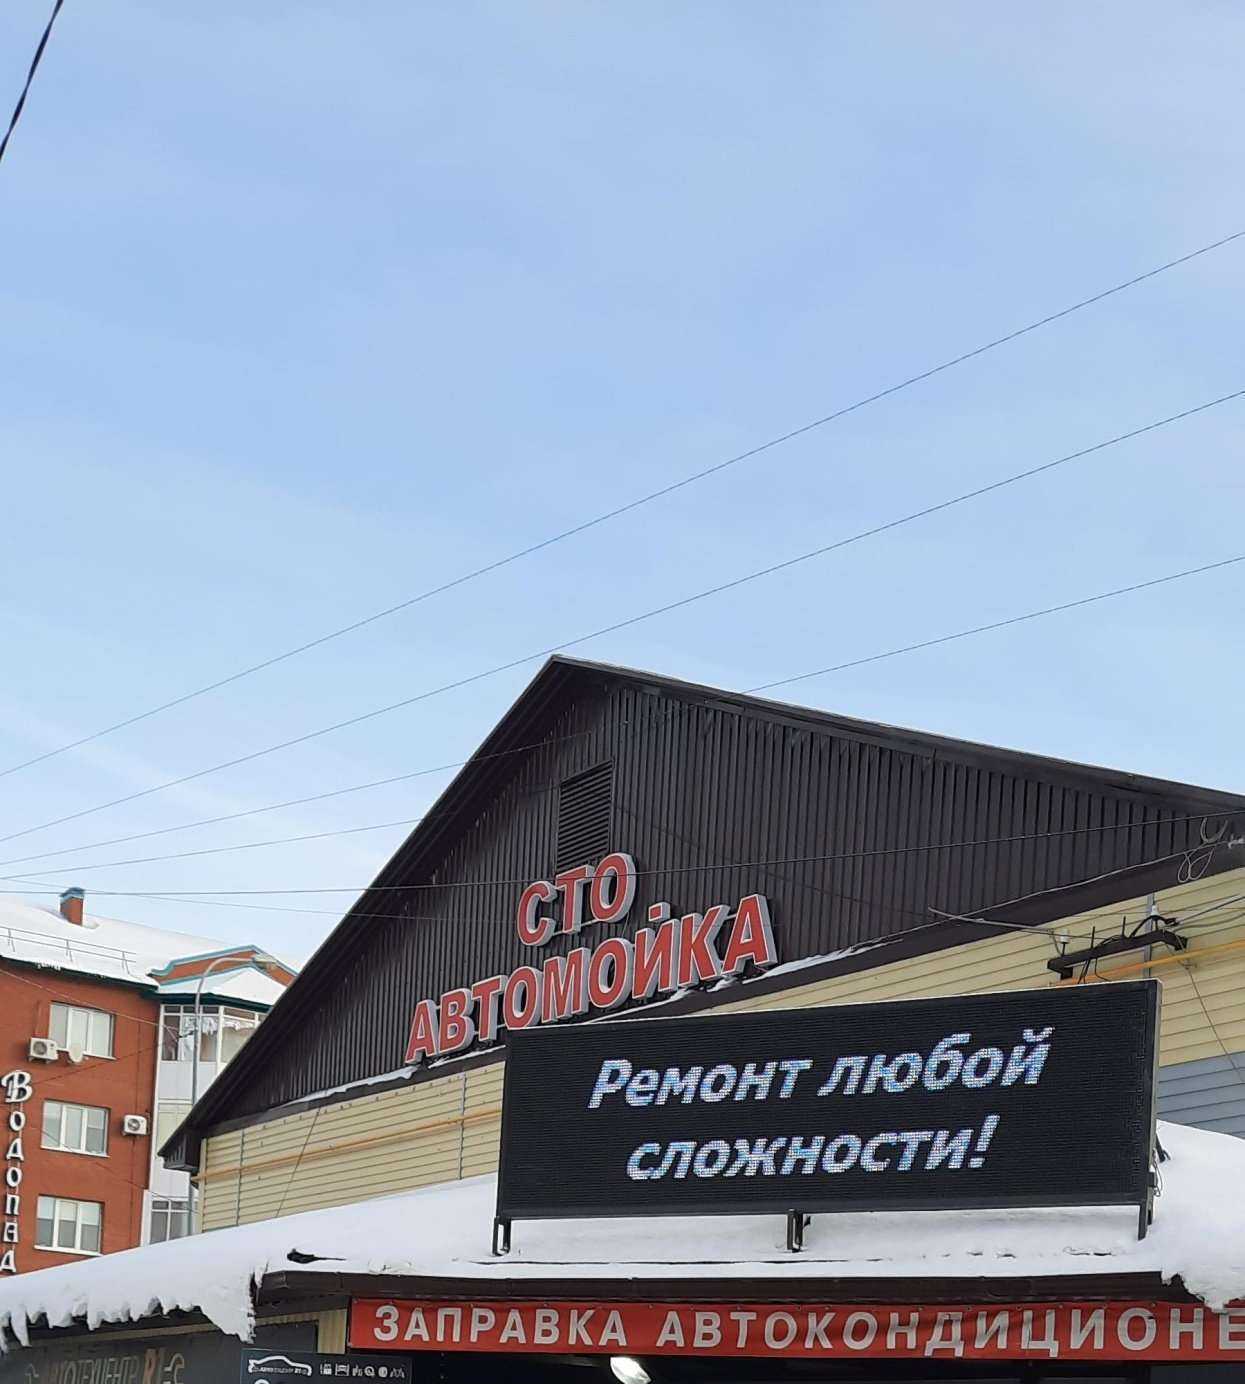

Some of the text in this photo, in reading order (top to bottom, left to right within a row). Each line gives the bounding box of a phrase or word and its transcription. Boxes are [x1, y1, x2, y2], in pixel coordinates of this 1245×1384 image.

[516, 852, 637, 946] СТО
[405, 893, 778, 1063] АВТОМОЙКА
[587, 1026, 1056, 1109] Ремонт любой
[626, 1114, 1000, 1180] сложности!
[374, 1305, 1245, 1358] ЗАПРАВКА АВТОКОНДИЦИОНЕ
